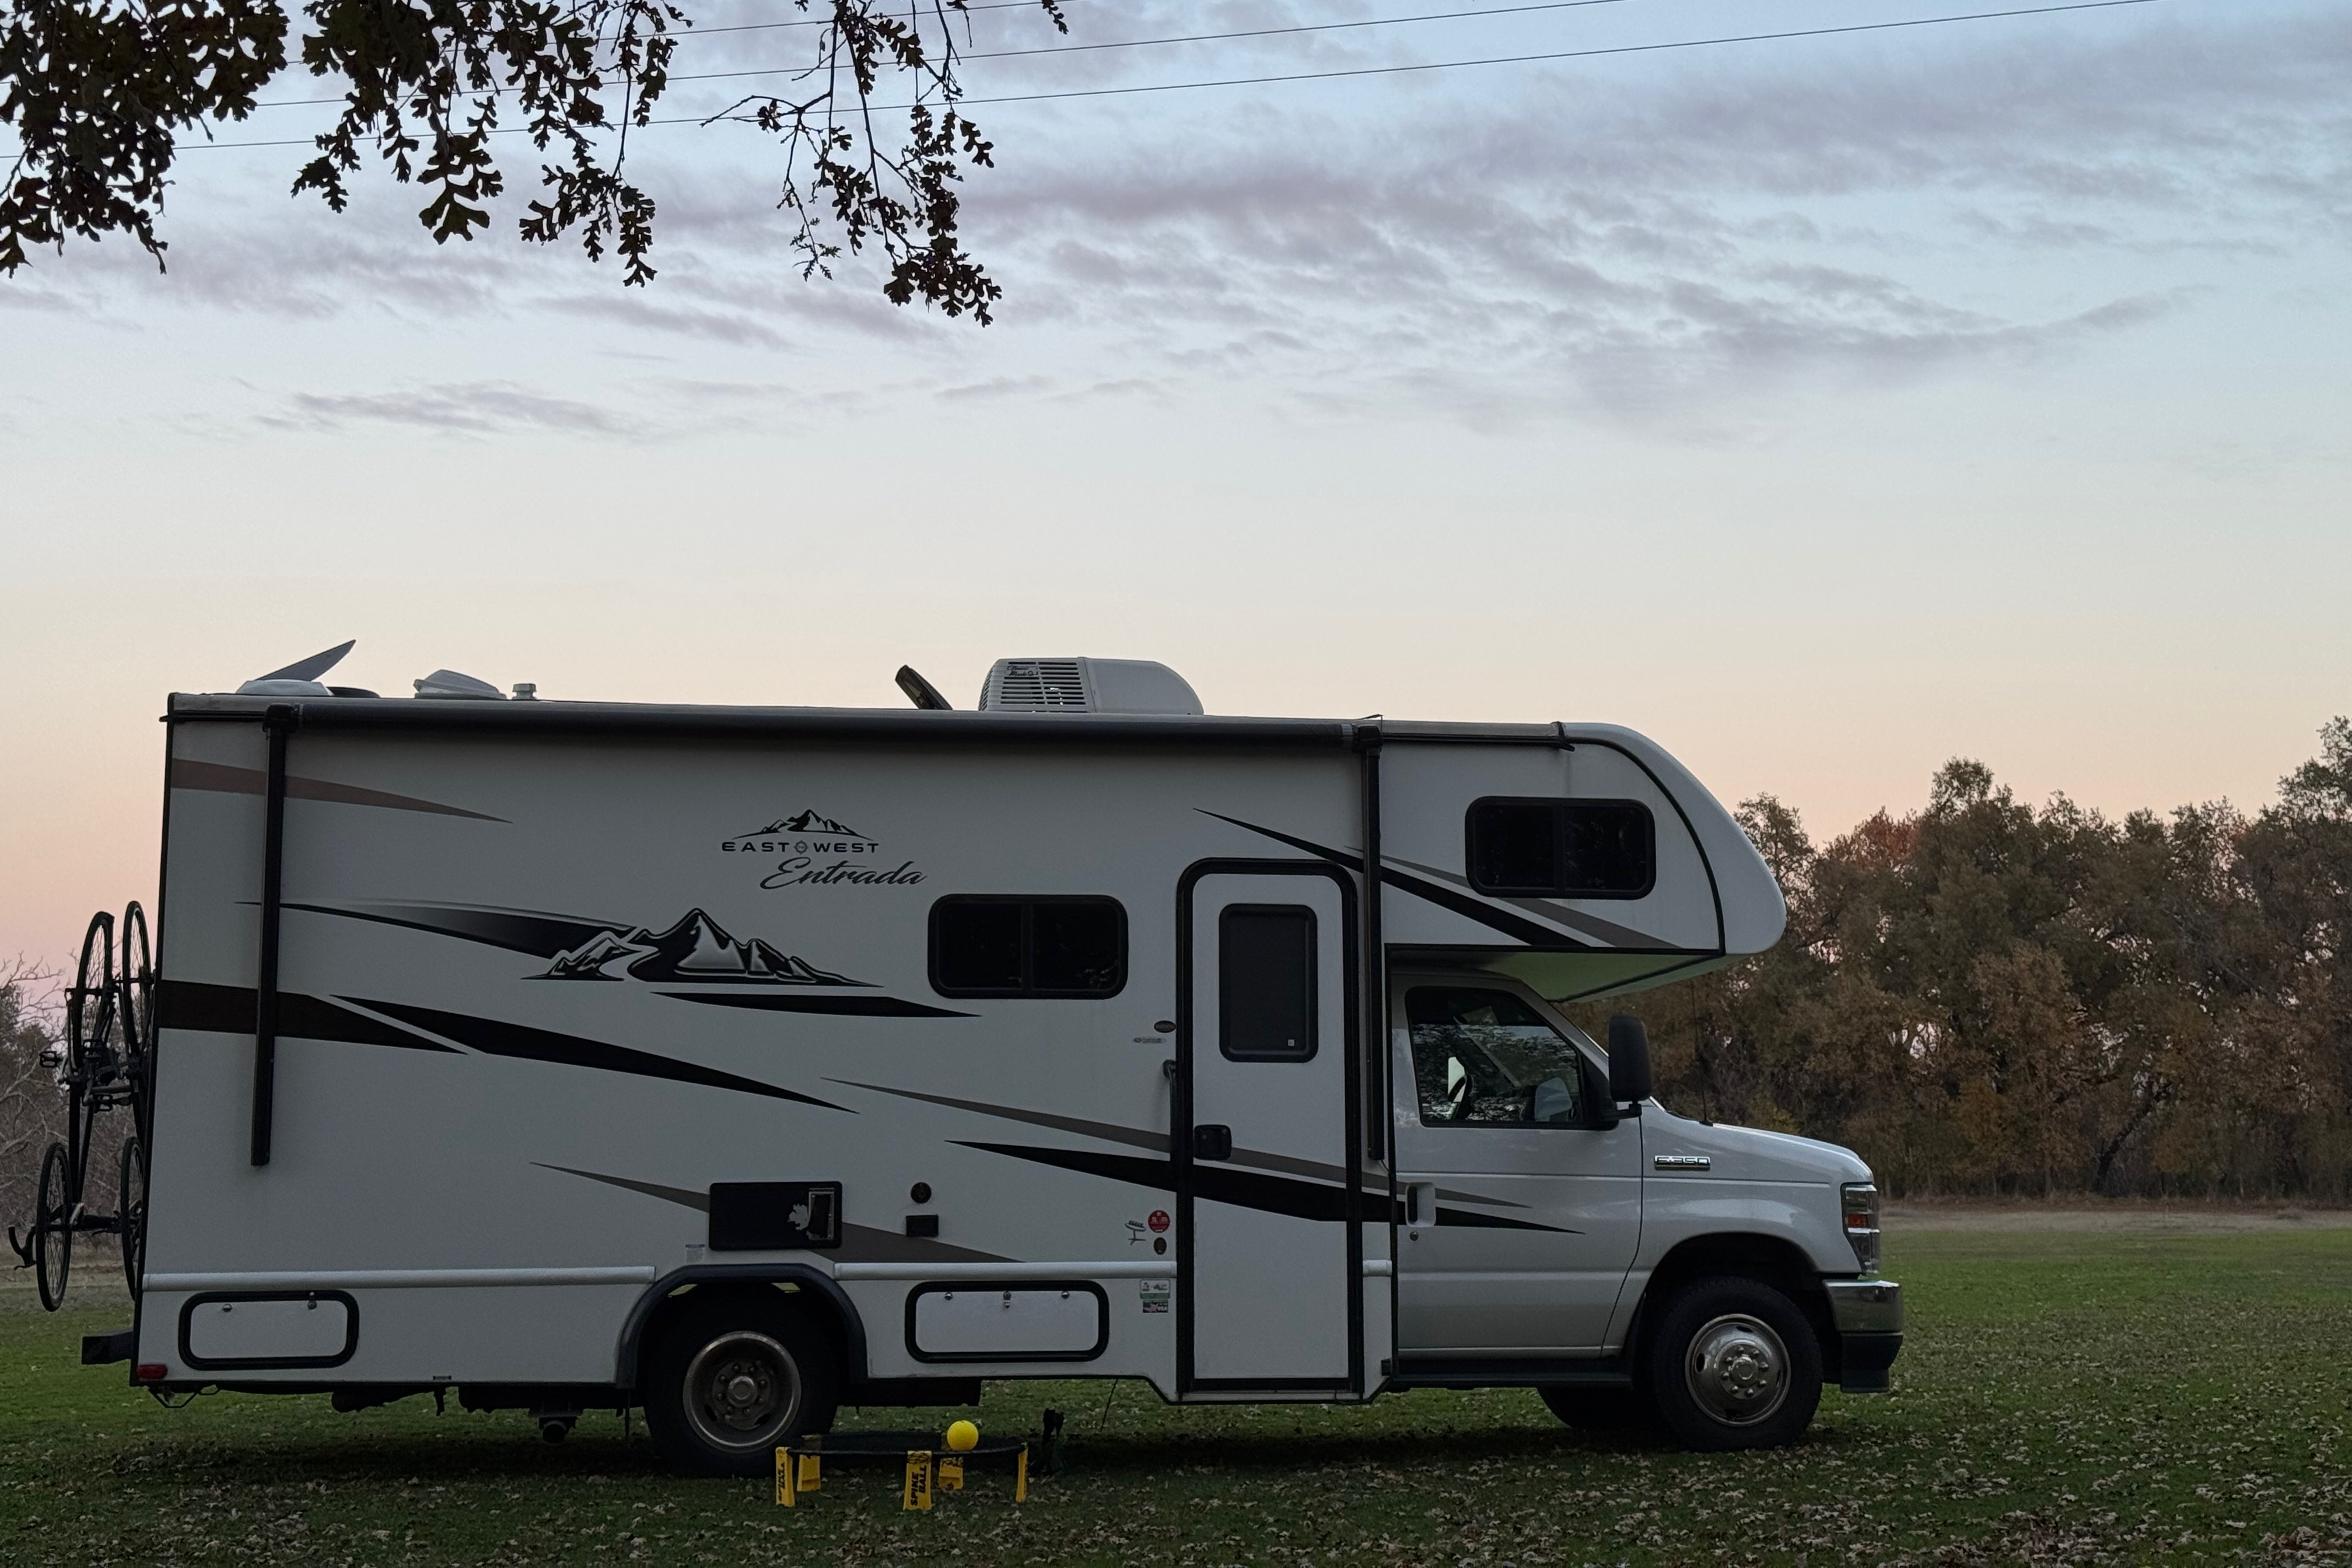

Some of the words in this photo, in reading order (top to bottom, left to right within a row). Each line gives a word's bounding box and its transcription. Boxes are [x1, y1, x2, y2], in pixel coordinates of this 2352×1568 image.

[722, 842, 790, 852] EAST
[813, 843, 879, 853] WEST
[760, 856, 928, 890] Entrada
[910, 1472, 918, 1506] SPIKE
[918, 1465, 926, 1493] BALL
